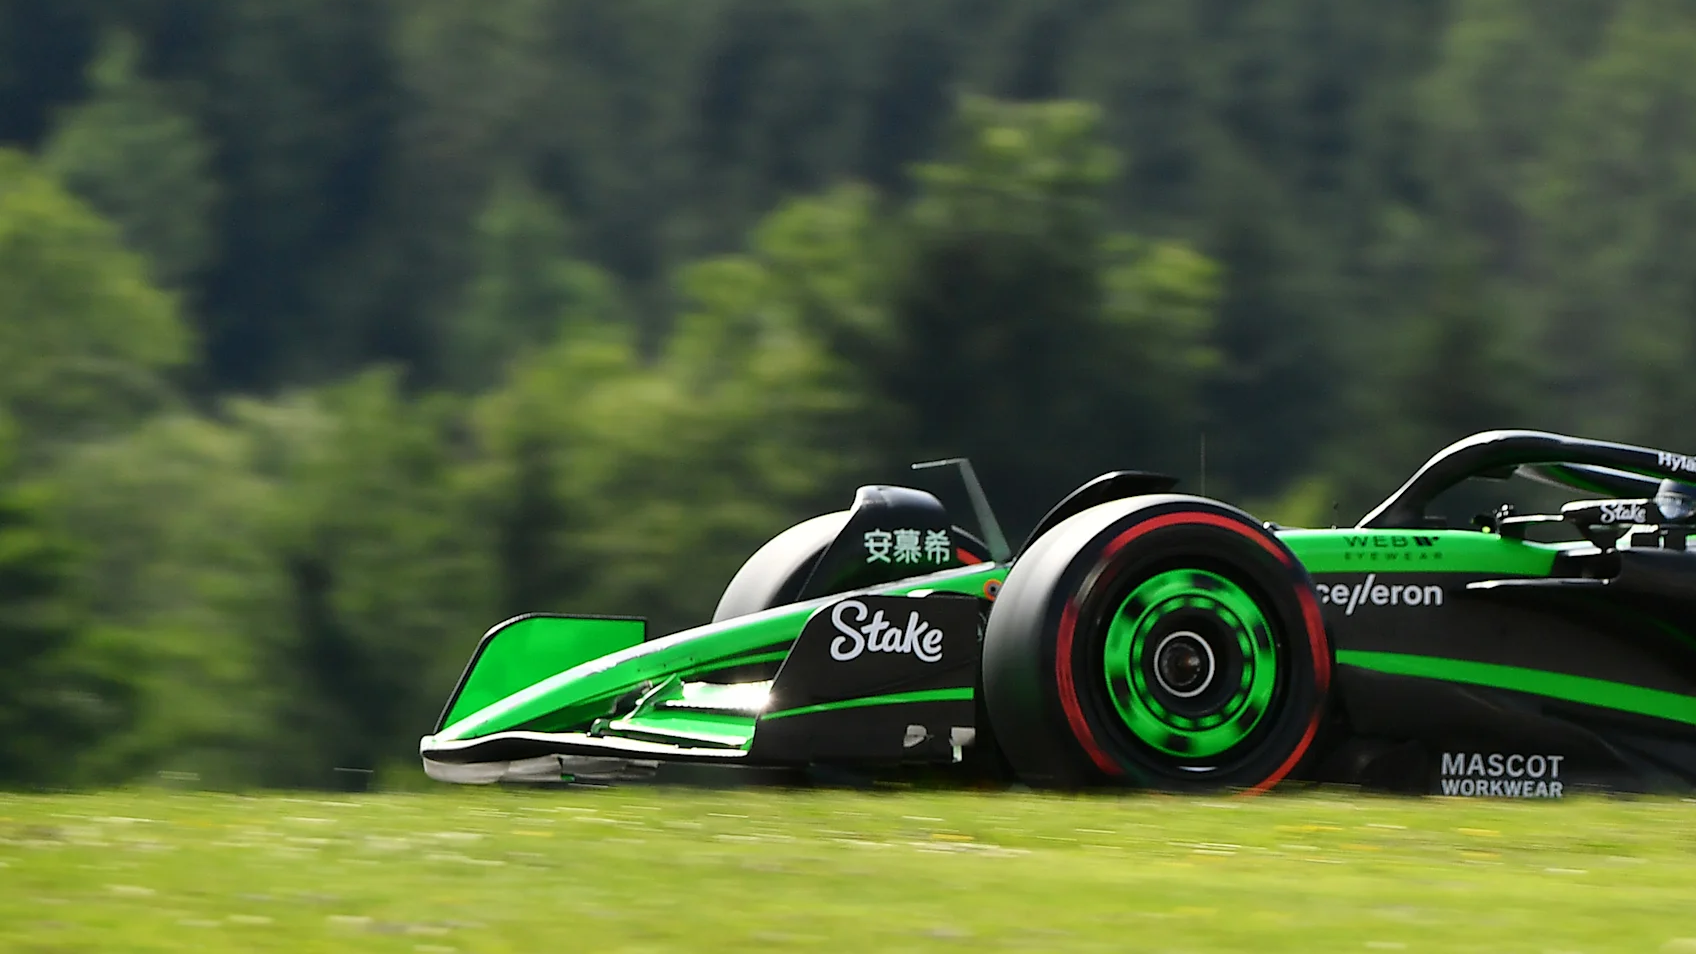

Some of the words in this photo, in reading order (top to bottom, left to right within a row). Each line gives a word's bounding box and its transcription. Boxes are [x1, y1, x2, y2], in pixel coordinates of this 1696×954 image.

[864, 528, 951, 564] 安慕希
[1343, 535, 1409, 548] WEB
[1344, 551, 1444, 561] EYEWEAR
[829, 599, 943, 662] Stake
[1441, 752, 1564, 779] MASCOT
[1441, 778, 1563, 798] WORKWEAR
